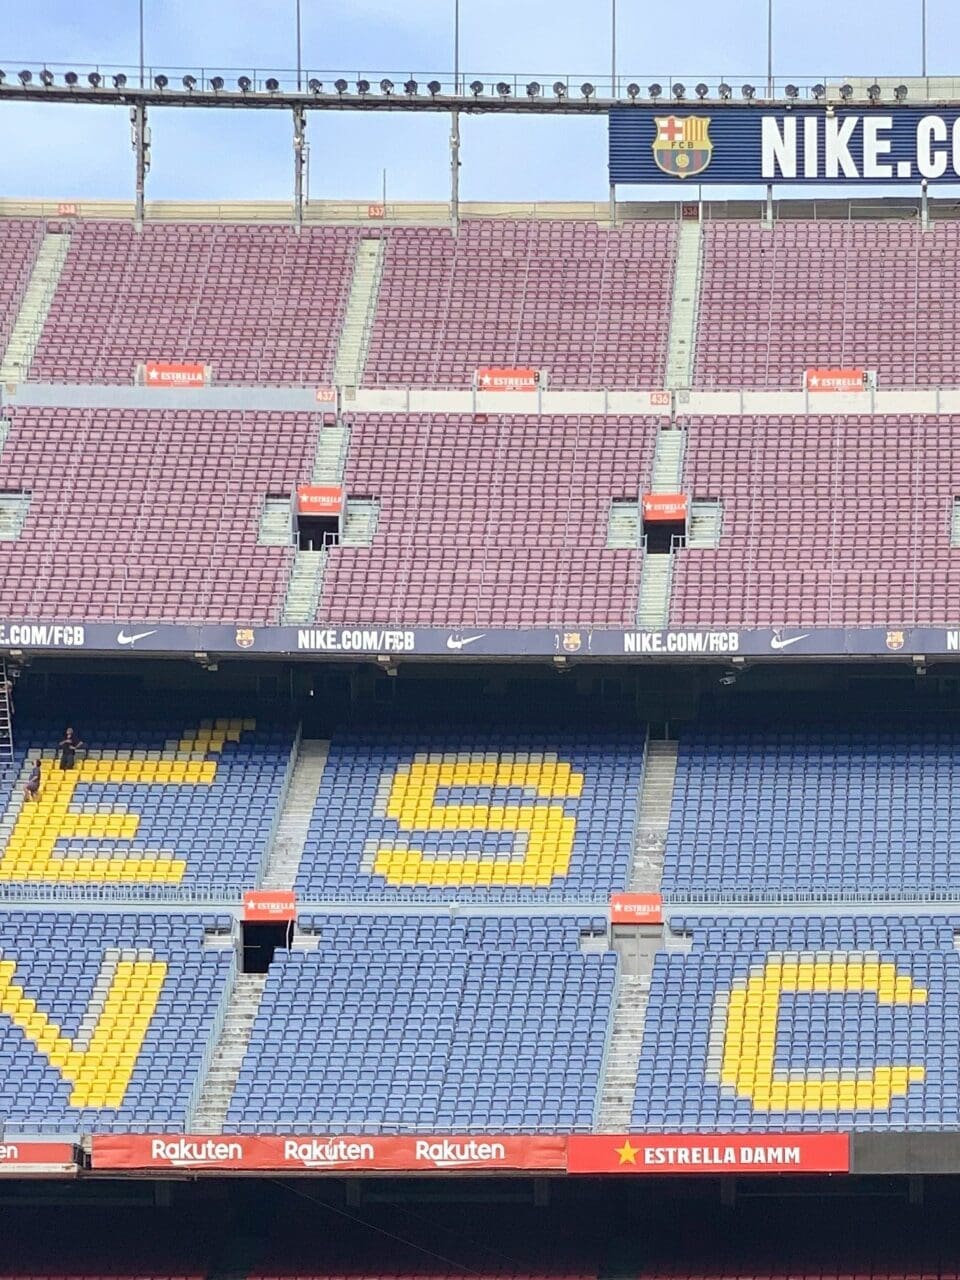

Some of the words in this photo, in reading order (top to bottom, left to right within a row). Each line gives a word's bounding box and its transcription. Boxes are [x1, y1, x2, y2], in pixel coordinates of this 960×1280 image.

[671, 141, 695, 149] FCB
[370, 205, 384, 217] 537
[160, 372, 203, 381] ESTRELLA
[493, 377, 535, 386] ESTRELLA
[822, 378, 863, 387] ESTRELLA
[316, 389, 335, 402] 437
[651, 392, 669, 405] 436
[298, 630, 415, 651] NIKE.COM/FCB
[624, 632, 739, 652] NIKE.COM/FCB
[152, 1139, 243, 1160] Rakuten
[285, 1140, 374, 1161] Rakuten
[416, 1140, 505, 1160] Rakuten
[644, 1147, 736, 1164] ESTRELLA
[740, 1146, 800, 1164] DAMM
